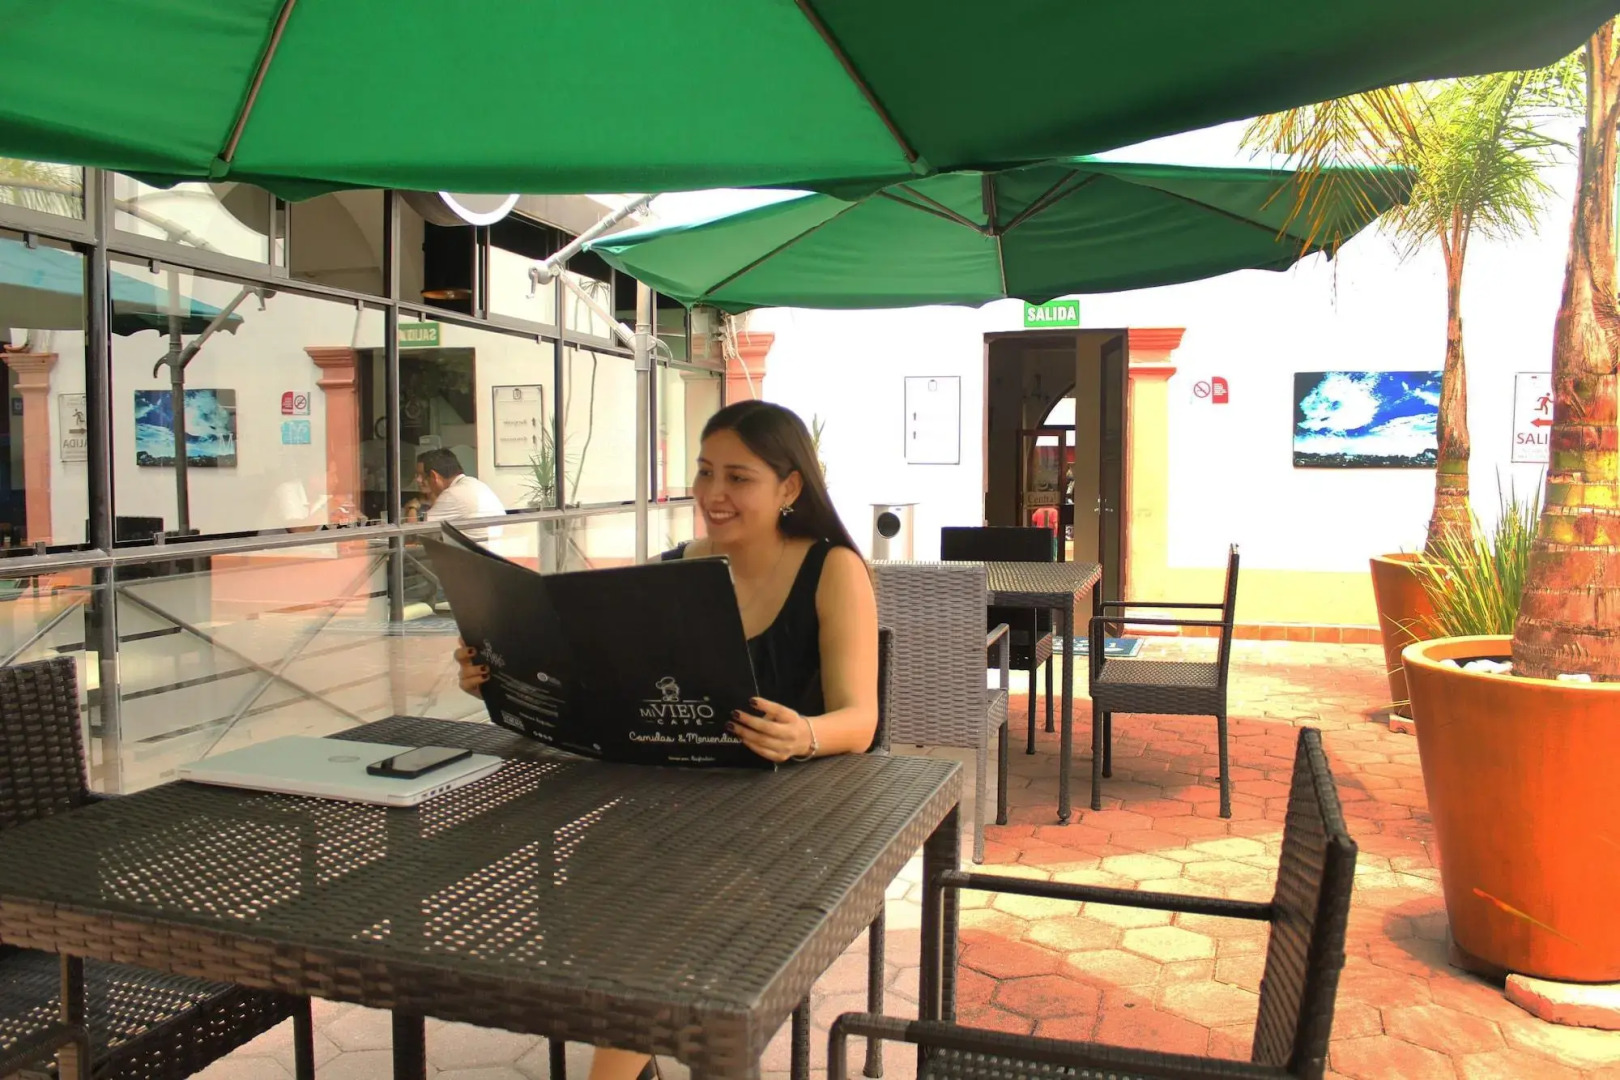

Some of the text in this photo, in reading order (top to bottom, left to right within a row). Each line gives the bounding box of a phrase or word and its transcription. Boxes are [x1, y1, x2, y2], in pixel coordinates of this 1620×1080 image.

[1027, 305, 1077, 321] SALIDA
[1516, 432, 1548, 445] SALI
[649, 703, 714, 719] VIEJO
[629, 731, 675, 742] Comidas
[685, 732, 742, 744] Meriendas
